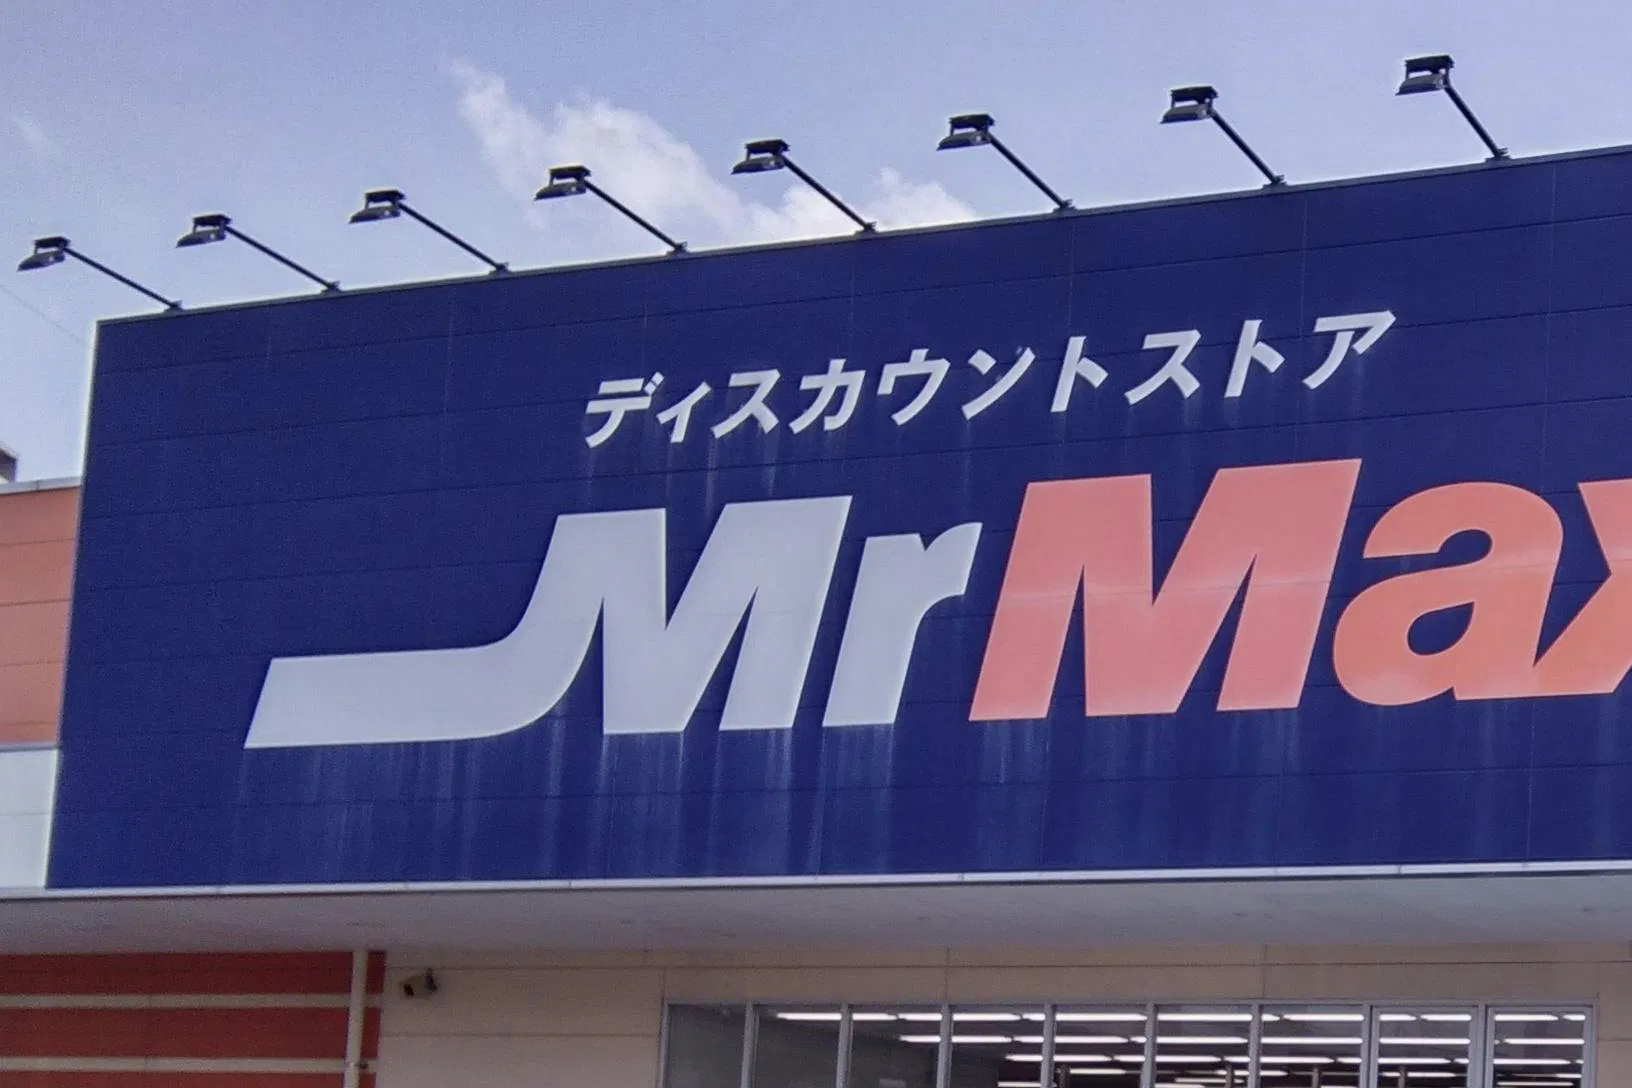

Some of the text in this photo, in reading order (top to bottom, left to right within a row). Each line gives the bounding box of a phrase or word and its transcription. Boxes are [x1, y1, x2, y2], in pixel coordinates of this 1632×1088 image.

[584, 310, 1397, 448] ディスカウントストア
